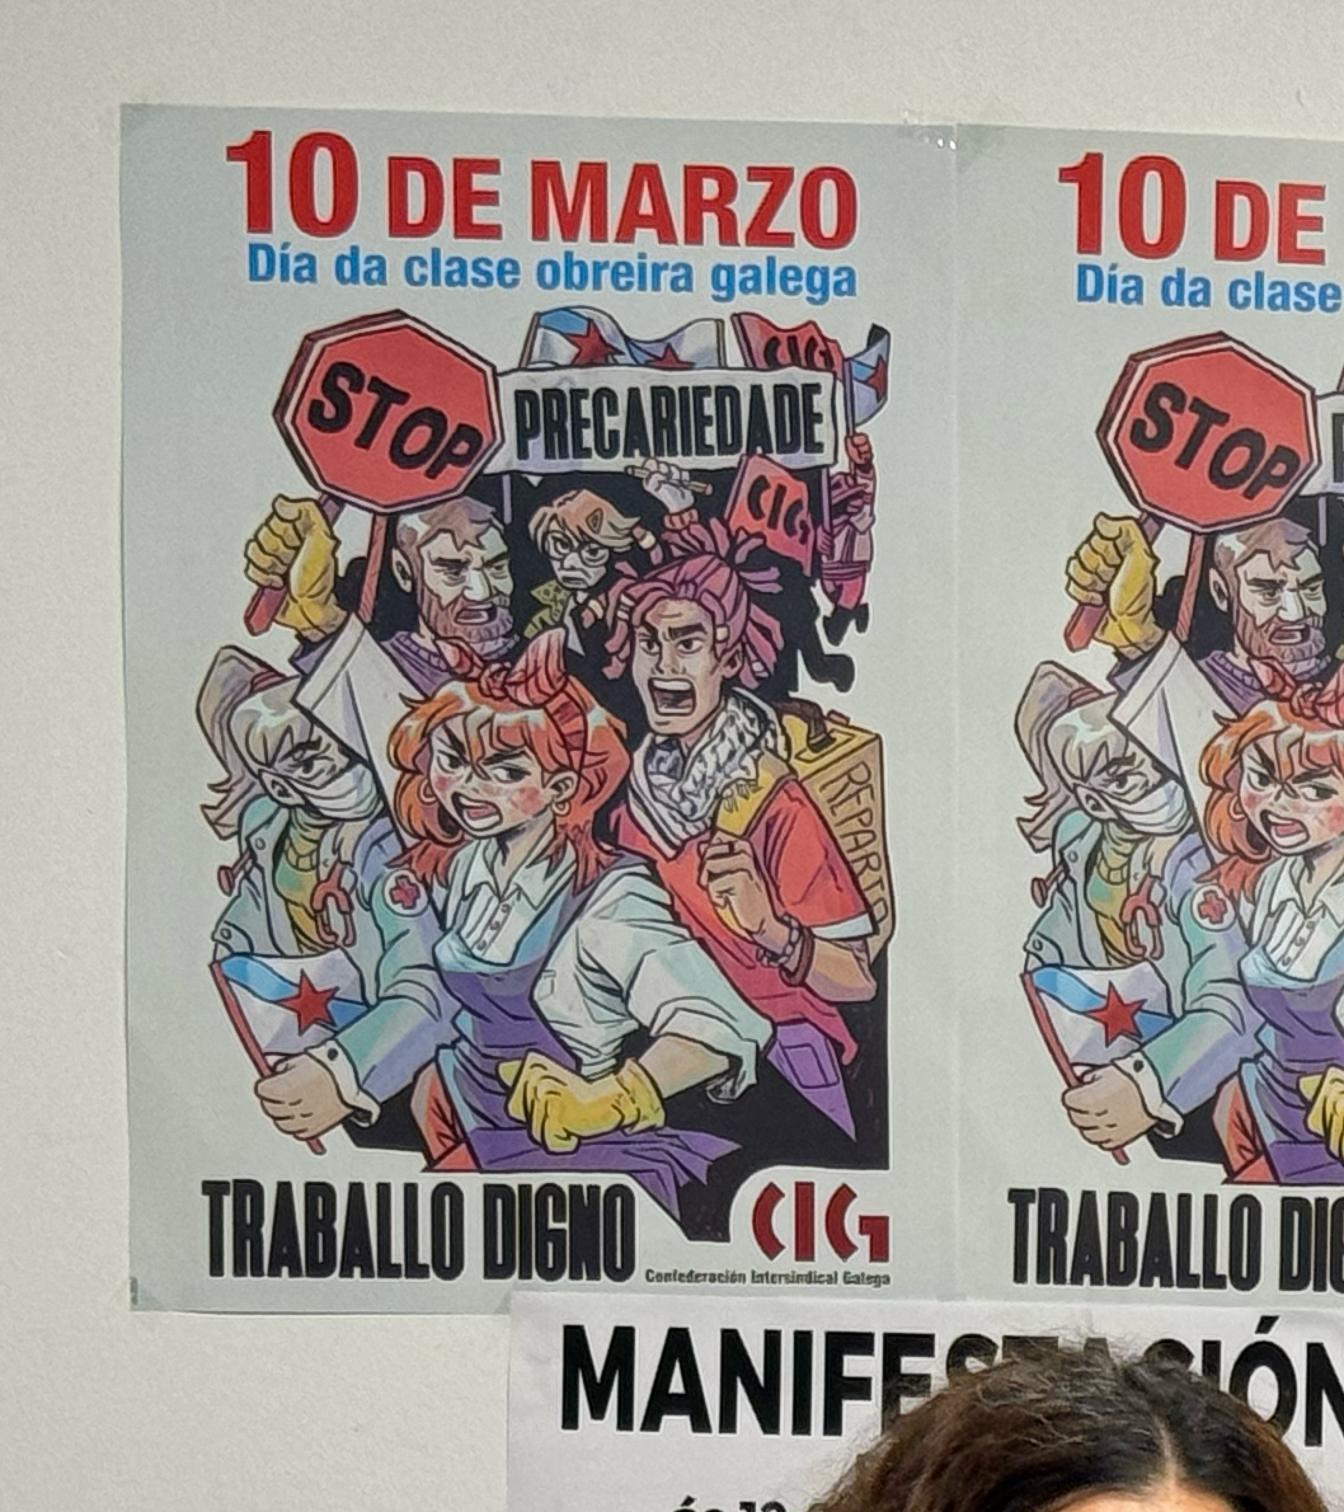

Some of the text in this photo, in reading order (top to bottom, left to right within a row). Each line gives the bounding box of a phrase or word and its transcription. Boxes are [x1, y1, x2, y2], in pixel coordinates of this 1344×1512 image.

[226, 130, 858, 249] 10 DE MARZO
[1058, 152, 1187, 259] 10
[1215, 180, 1327, 265] DE
[248, 243, 857, 304] Día da clase obreira galega
[1076, 263, 1143, 305] Día
[1161, 268, 1211, 308] da
[1229, 271, 1342, 313] clase
[308, 362, 483, 481] STOP
[515, 381, 826, 461] PRECARIEDADE
[1130, 382, 1300, 501] STOP
[202, 1179, 636, 1282] TRABALLO DIGNO
[752, 1181, 889, 1262] CIG
[1007, 1189, 1261, 1292] TRABALLO
[646, 1269, 891, 1288] Confederación Intersindical Galega
